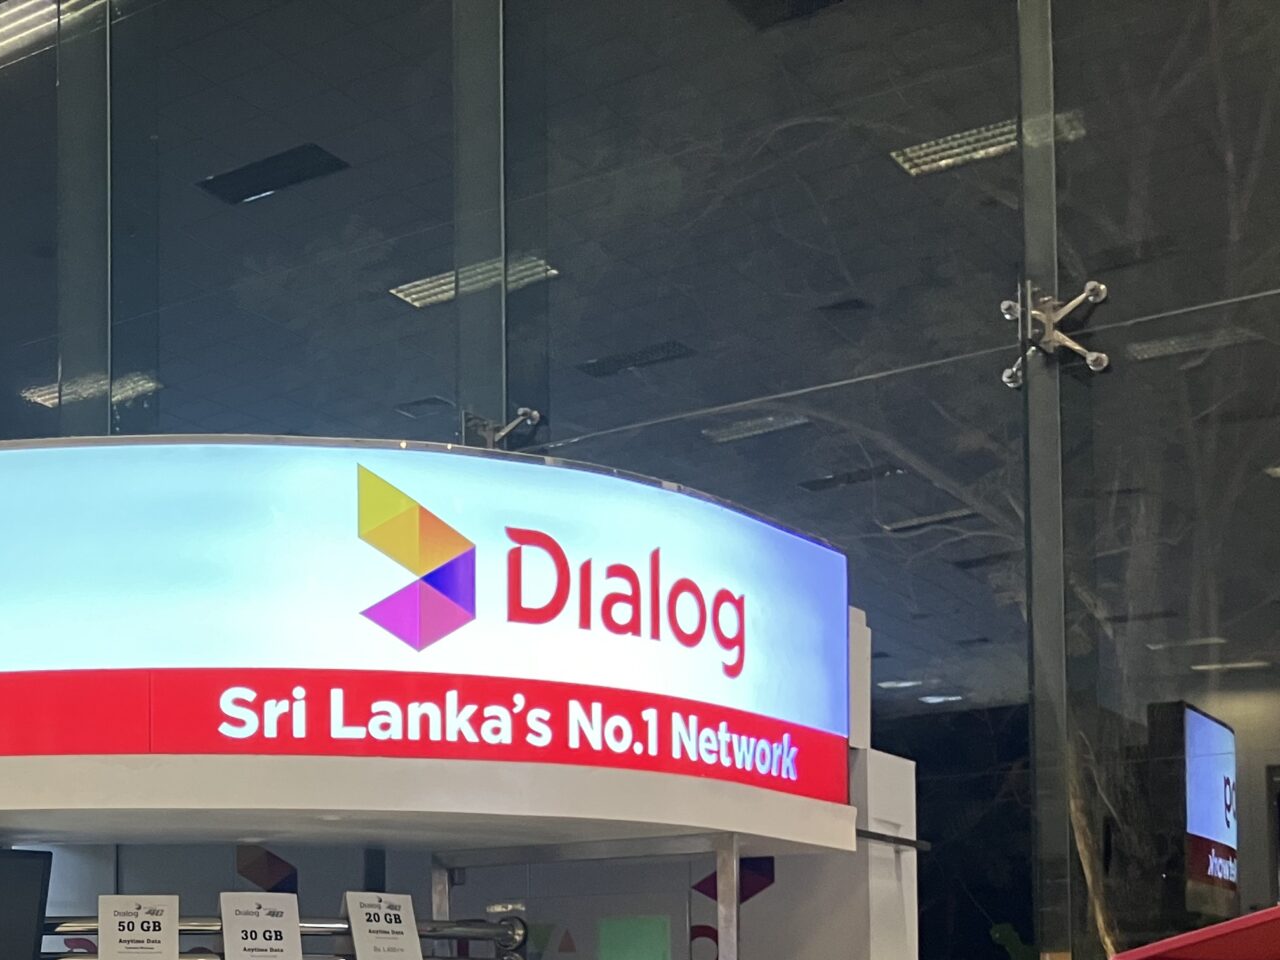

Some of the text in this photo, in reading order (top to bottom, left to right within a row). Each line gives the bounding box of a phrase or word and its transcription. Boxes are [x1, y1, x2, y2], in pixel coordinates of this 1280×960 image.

[504, 526, 746, 679] Dialog
[217, 686, 798, 782] Sri Lanka’s No.1 Network
[365, 912, 402, 924] 20 GB
[118, 920, 162, 932] 50 GB
[241, 930, 284, 941] 30 GB
